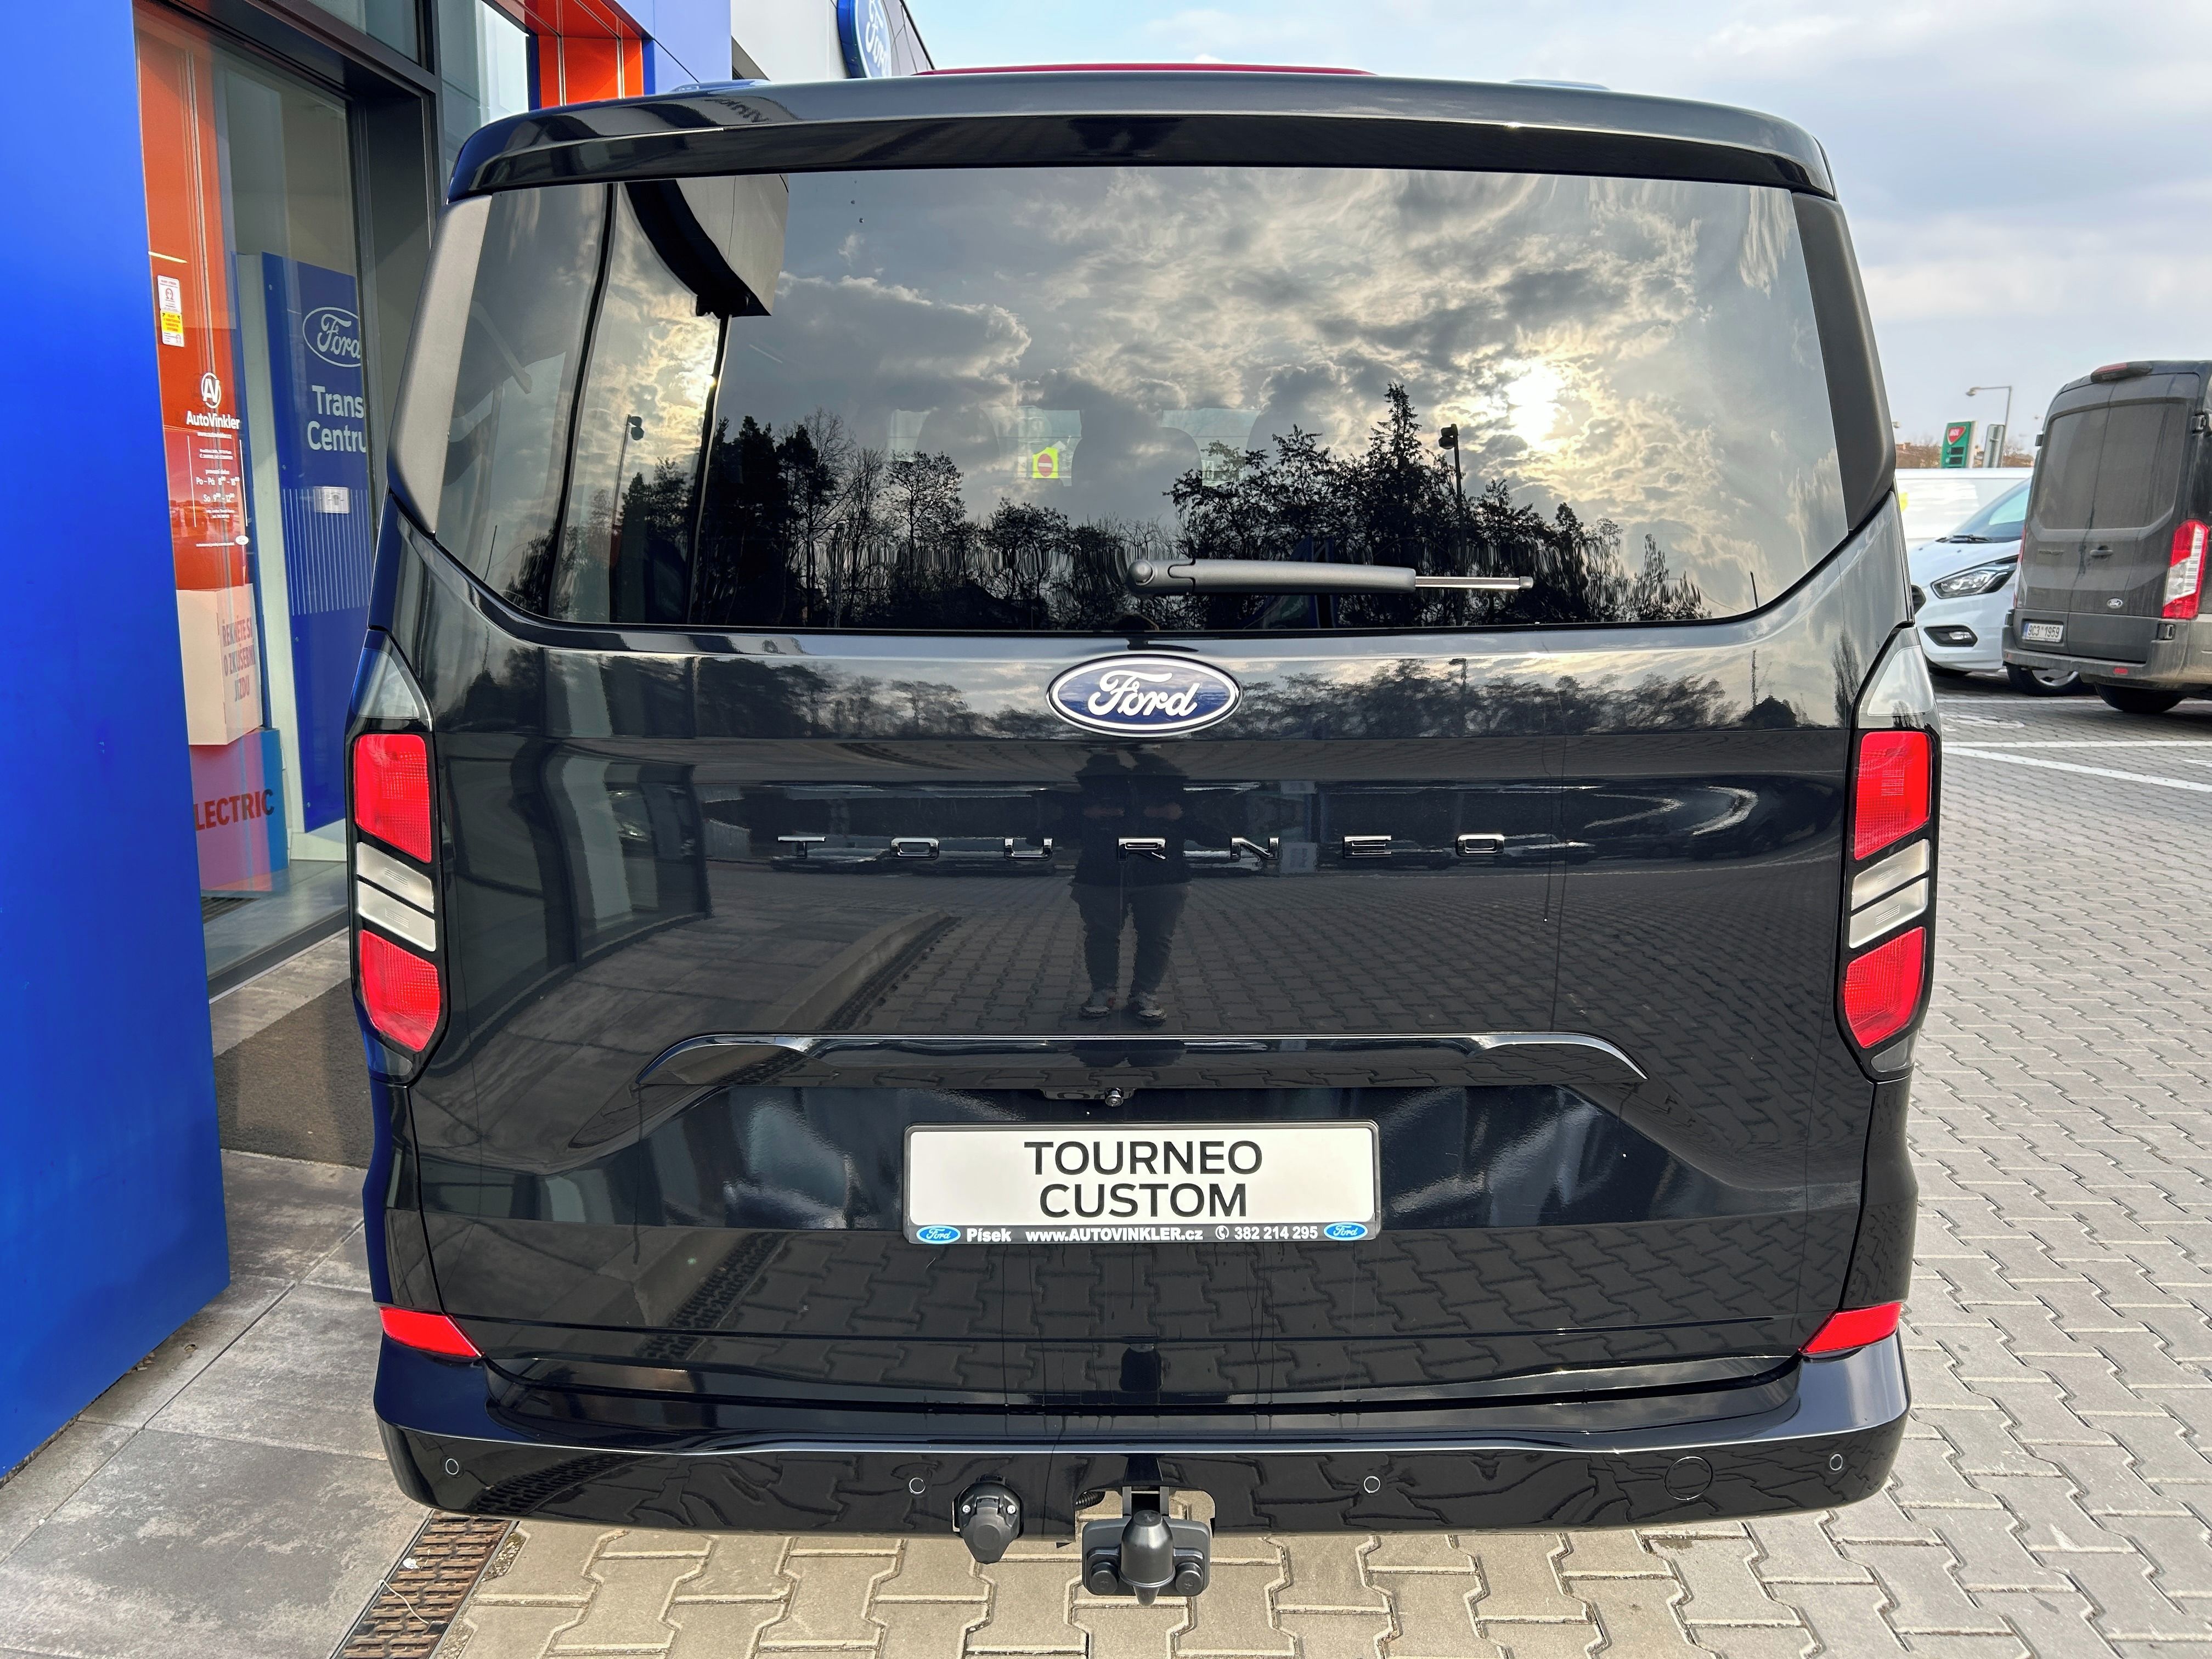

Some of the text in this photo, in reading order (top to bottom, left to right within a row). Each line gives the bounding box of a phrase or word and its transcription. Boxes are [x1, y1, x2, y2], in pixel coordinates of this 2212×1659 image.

[312, 385, 364, 419] Trans
[187, 410, 240, 430] AutoVinkler
[247, 617, 252, 639] SI
[224, 654, 228, 676] O
[1088, 670, 1200, 716] Ford
[777, 833, 1505, 860] TOURNEO
[1024, 1140, 1262, 1175] TOURNEO
[1040, 1183, 1246, 1218] CUSTOM
[926, 1225, 1358, 1242] Ford Písek www.AUTOVINKLER.cz 382 214 295 Ford
